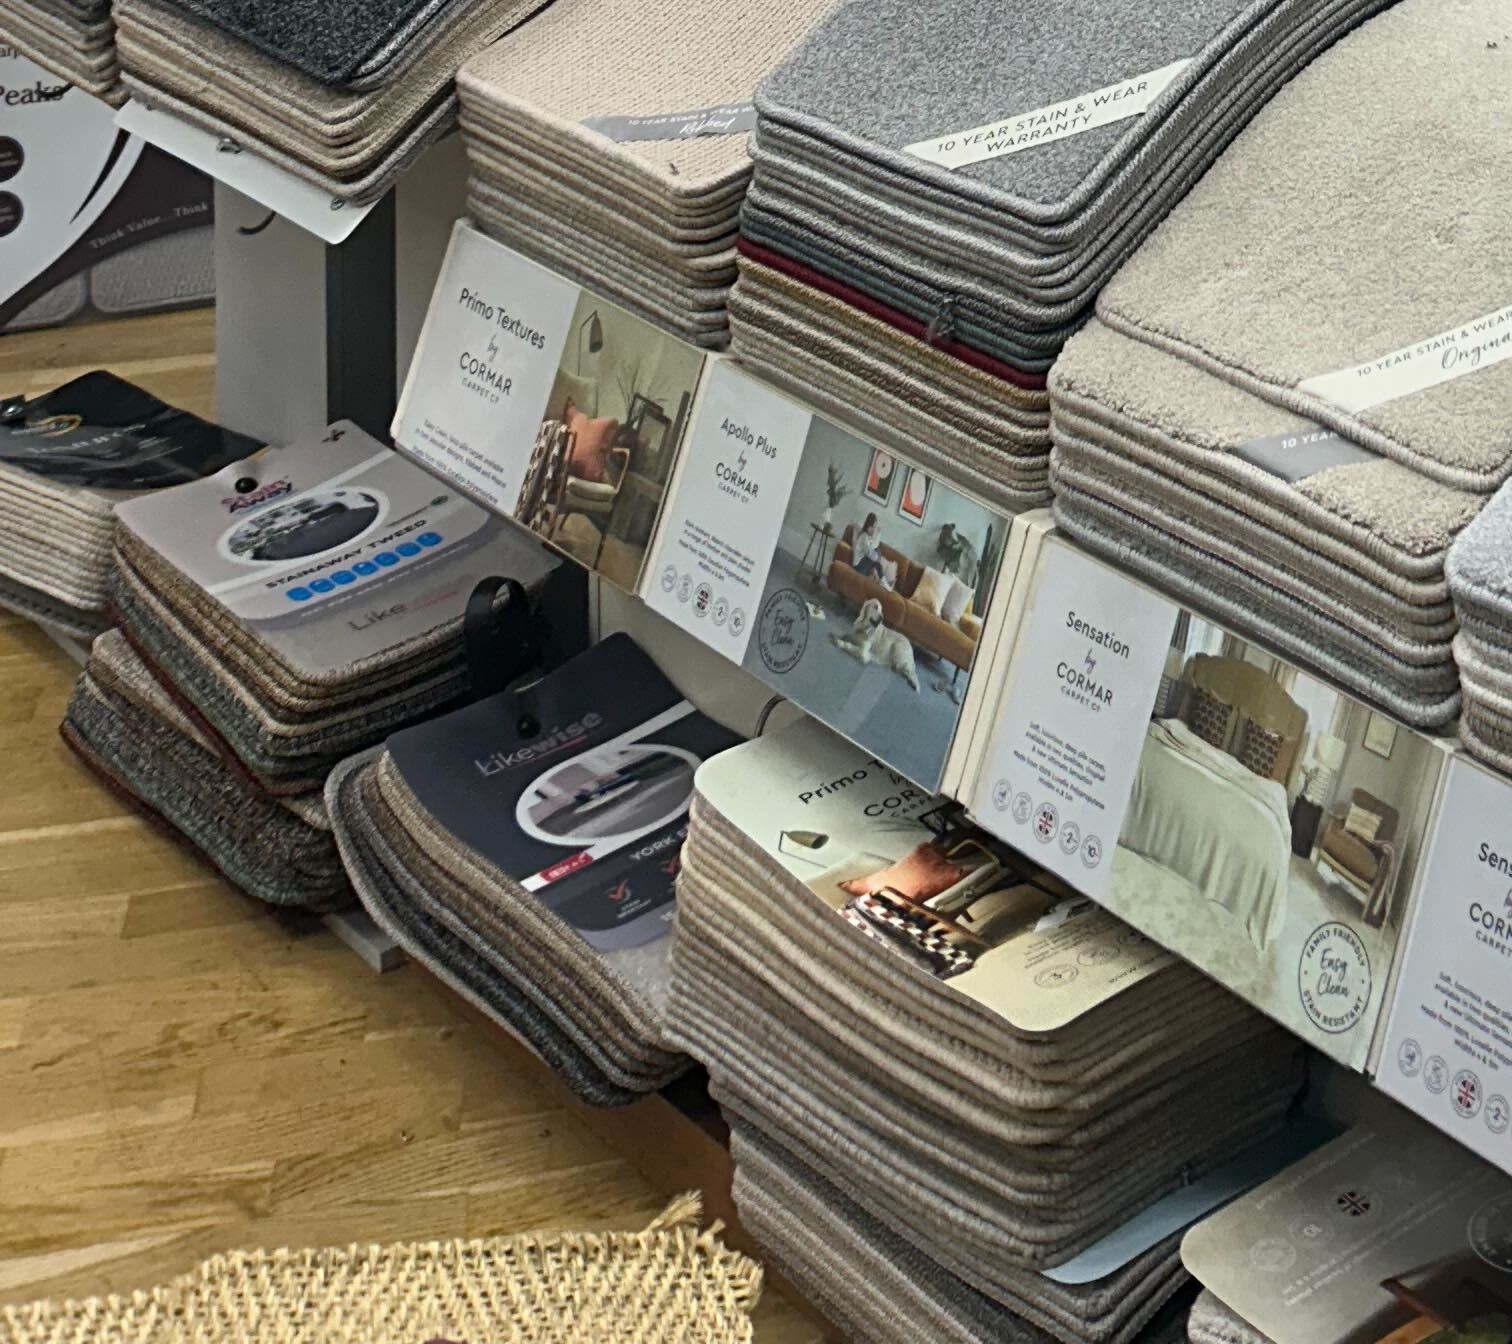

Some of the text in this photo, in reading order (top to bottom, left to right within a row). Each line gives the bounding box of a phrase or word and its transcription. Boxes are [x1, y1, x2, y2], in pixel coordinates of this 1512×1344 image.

[938, 81, 1148, 153] 10 YEAR STAIN & WEAR
[987, 113, 1093, 153] WARRANTY
[88, 201, 209, 249] Think Think
[459, 288, 546, 350] Primo Textures
[486, 333, 499, 363] by
[1357, 366, 1372, 377] 10
[1376, 351, 1412, 371] YEAR
[1417, 334, 1456, 355] STAIN
[1460, 327, 1469, 338] &
[459, 352, 512, 396] CORMAR
[461, 376, 489, 399] CARPET
[720, 417, 777, 460] Apollo Plus
[1281, 437, 1297, 449] 10
[737, 449, 747, 472] by
[715, 462, 759, 498] CORMAR
[718, 481, 740, 499] CARPET
[265, 519, 427, 589] STAINAWAY TWEED
[1066, 610, 1131, 660] Sensation
[1084, 647, 1097, 675] by
[1056, 662, 1114, 706] CORMAR
[1060, 685, 1090, 706] CARPET
[474, 712, 602, 777] Likewise
[798, 769, 868, 805] Primo
[630, 835, 677, 861] YORK
[1306, 927, 1366, 967] FAMILY FRIENDLY
[1475, 929, 1512, 958] CARPET
[1317, 971, 1349, 997] Clean
[1320, 947, 1348, 984] Easy
[1303, 990, 1363, 1027] STAIN RESISTANT
